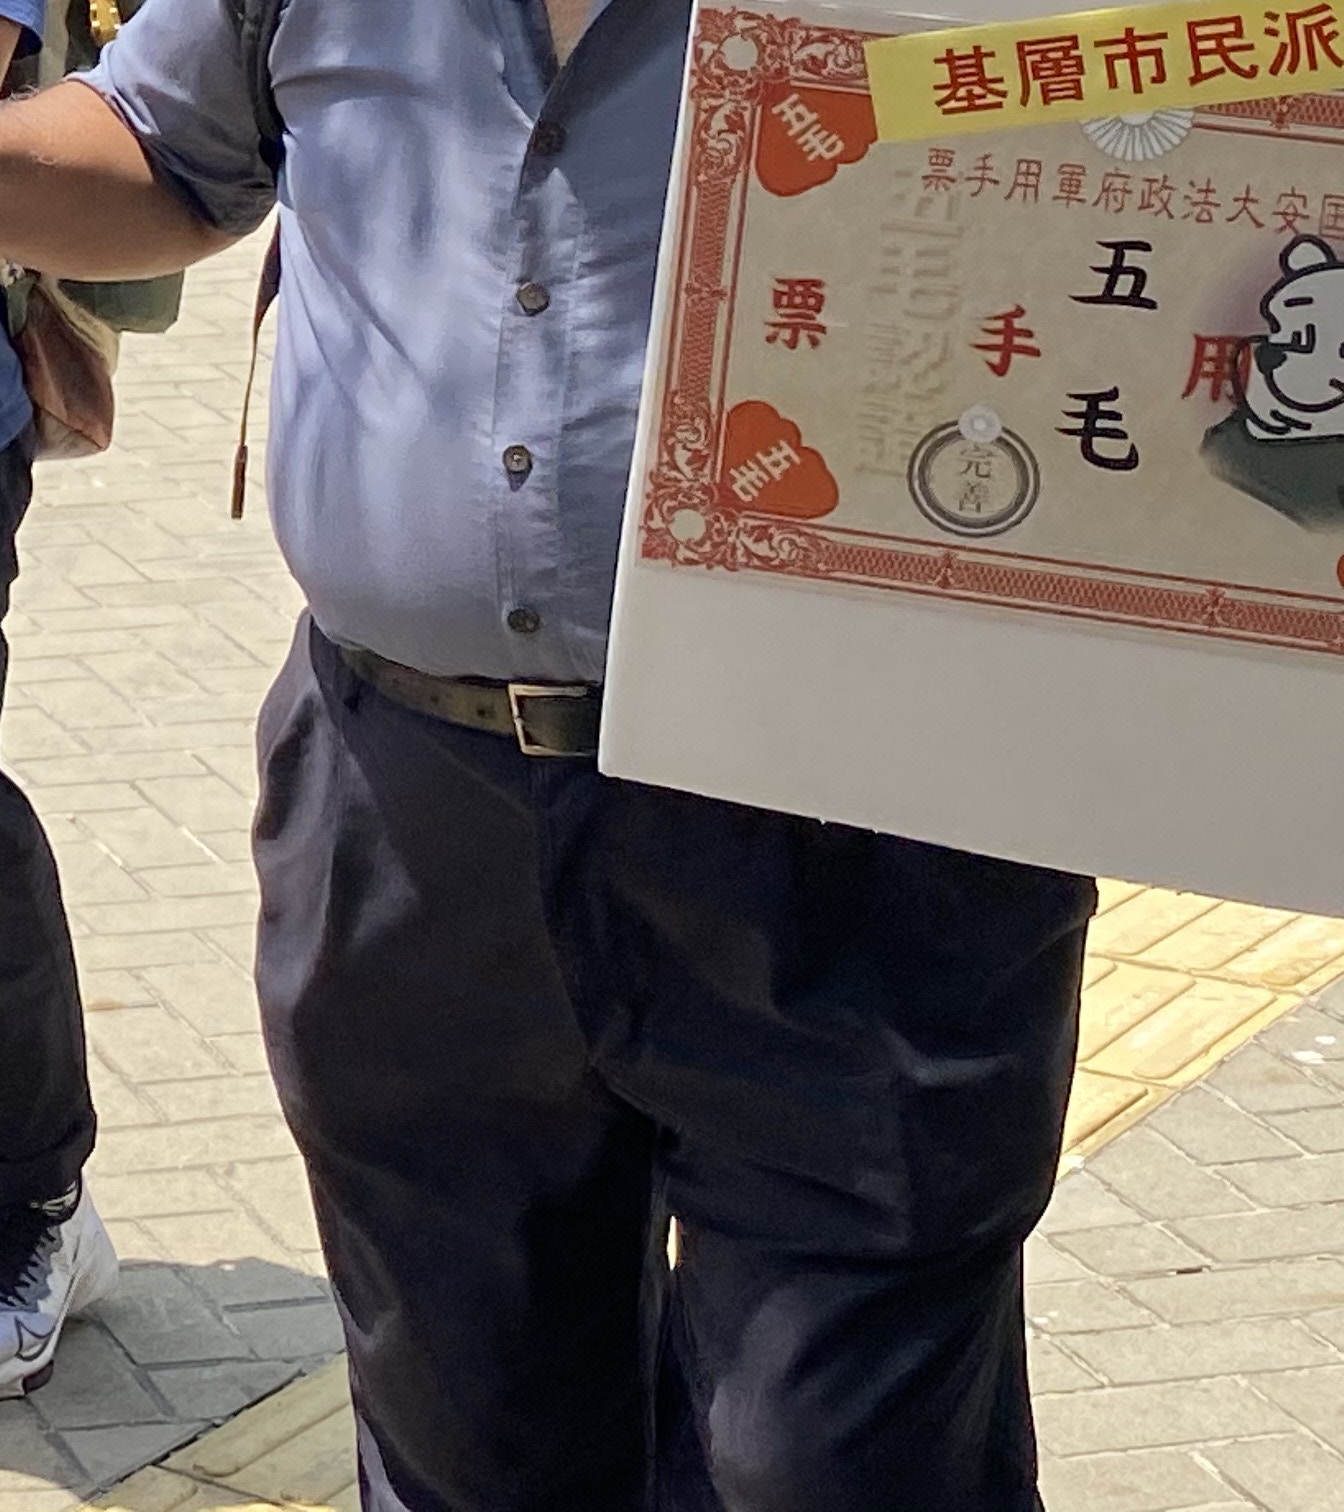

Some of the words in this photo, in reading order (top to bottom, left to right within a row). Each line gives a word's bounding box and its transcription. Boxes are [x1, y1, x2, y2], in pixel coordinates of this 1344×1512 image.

[932, 3, 1344, 116] 基層市民派
[771, 92, 845, 162] 五毛
[728, 439, 801, 502] 五毛
